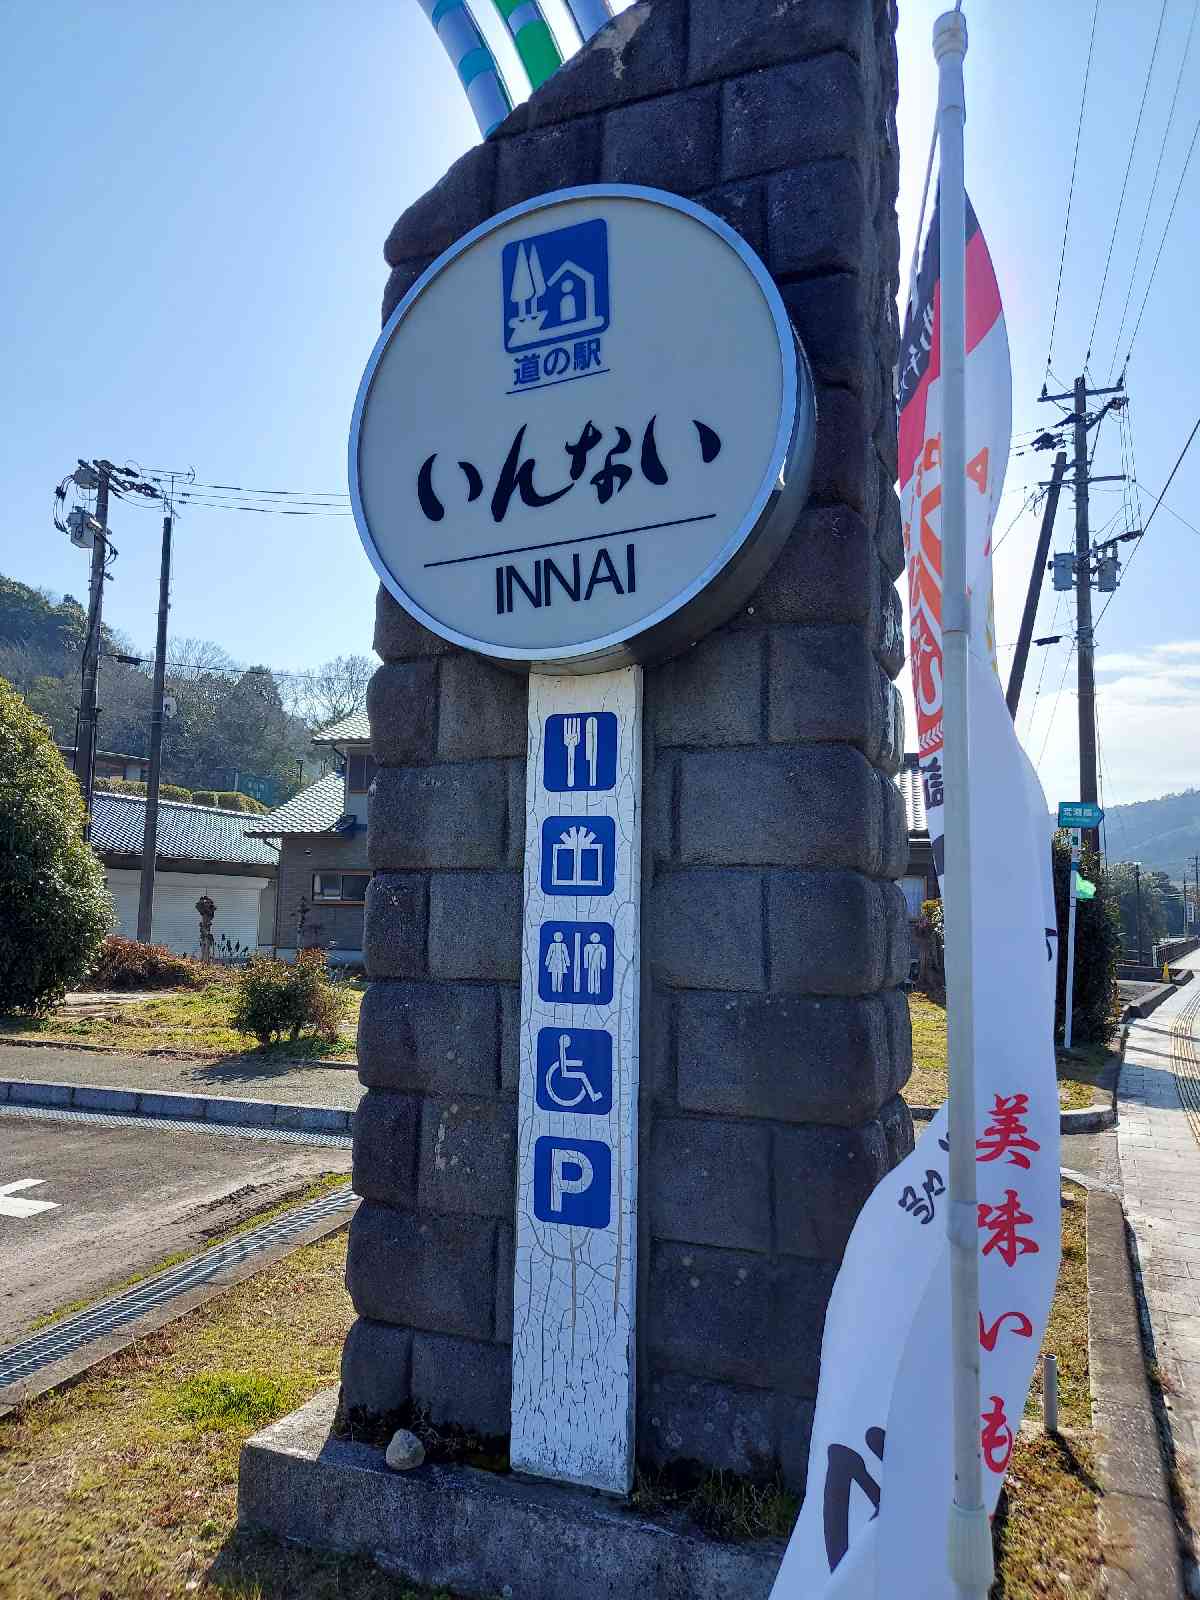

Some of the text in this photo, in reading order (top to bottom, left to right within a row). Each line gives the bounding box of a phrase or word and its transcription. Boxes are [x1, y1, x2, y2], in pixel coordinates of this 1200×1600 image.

[513, 338, 601, 385] 道の駅
[418, 415, 721, 522] いんない
[496, 545, 636, 614] INNAI
[550, 1147, 594, 1213] P
